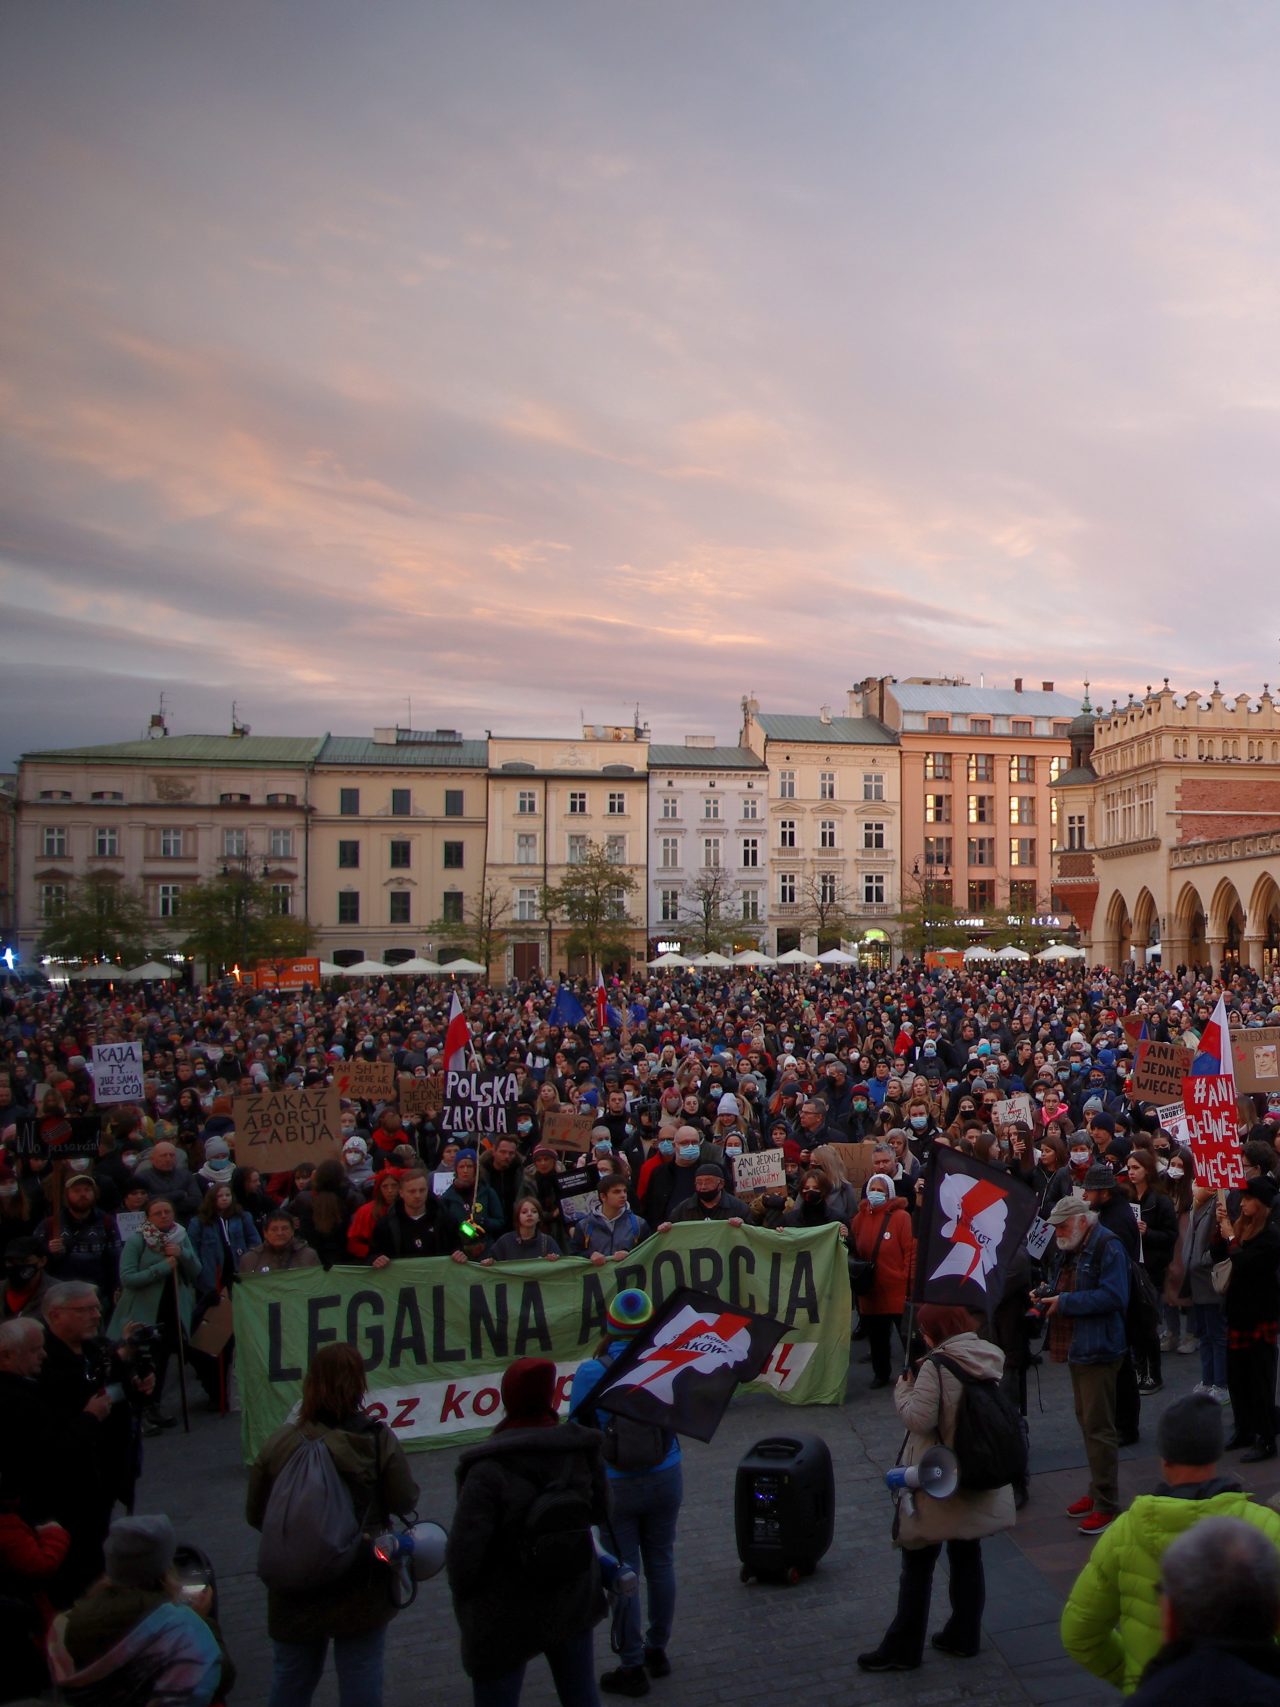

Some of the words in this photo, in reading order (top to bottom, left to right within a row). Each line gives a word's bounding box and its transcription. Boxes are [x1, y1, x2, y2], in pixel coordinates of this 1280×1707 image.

[1146, 1044, 1175, 1061] ANI
[336, 1064, 351, 1073] AH
[1141, 1060, 1190, 1080] JEDNEJ
[350, 1085, 364, 1094] GO
[446, 1071, 519, 1107] POLSKA
[1136, 1076, 1183, 1096] WIĘCEJ
[1193, 1077, 1234, 1107] #ANI
[247, 1091, 328, 1113] ZAKAZ
[243, 1109, 327, 1131] ABORCJI
[442, 1105, 508, 1133] ZABIJA
[1187, 1110, 1240, 1148] JEDNEJ
[247, 1124, 334, 1146] ZABIJA
[738, 1156, 753, 1169] ANI
[1193, 1151, 1245, 1188] WIĘCEJ
[268, 1281, 552, 1383] LEGALNA
